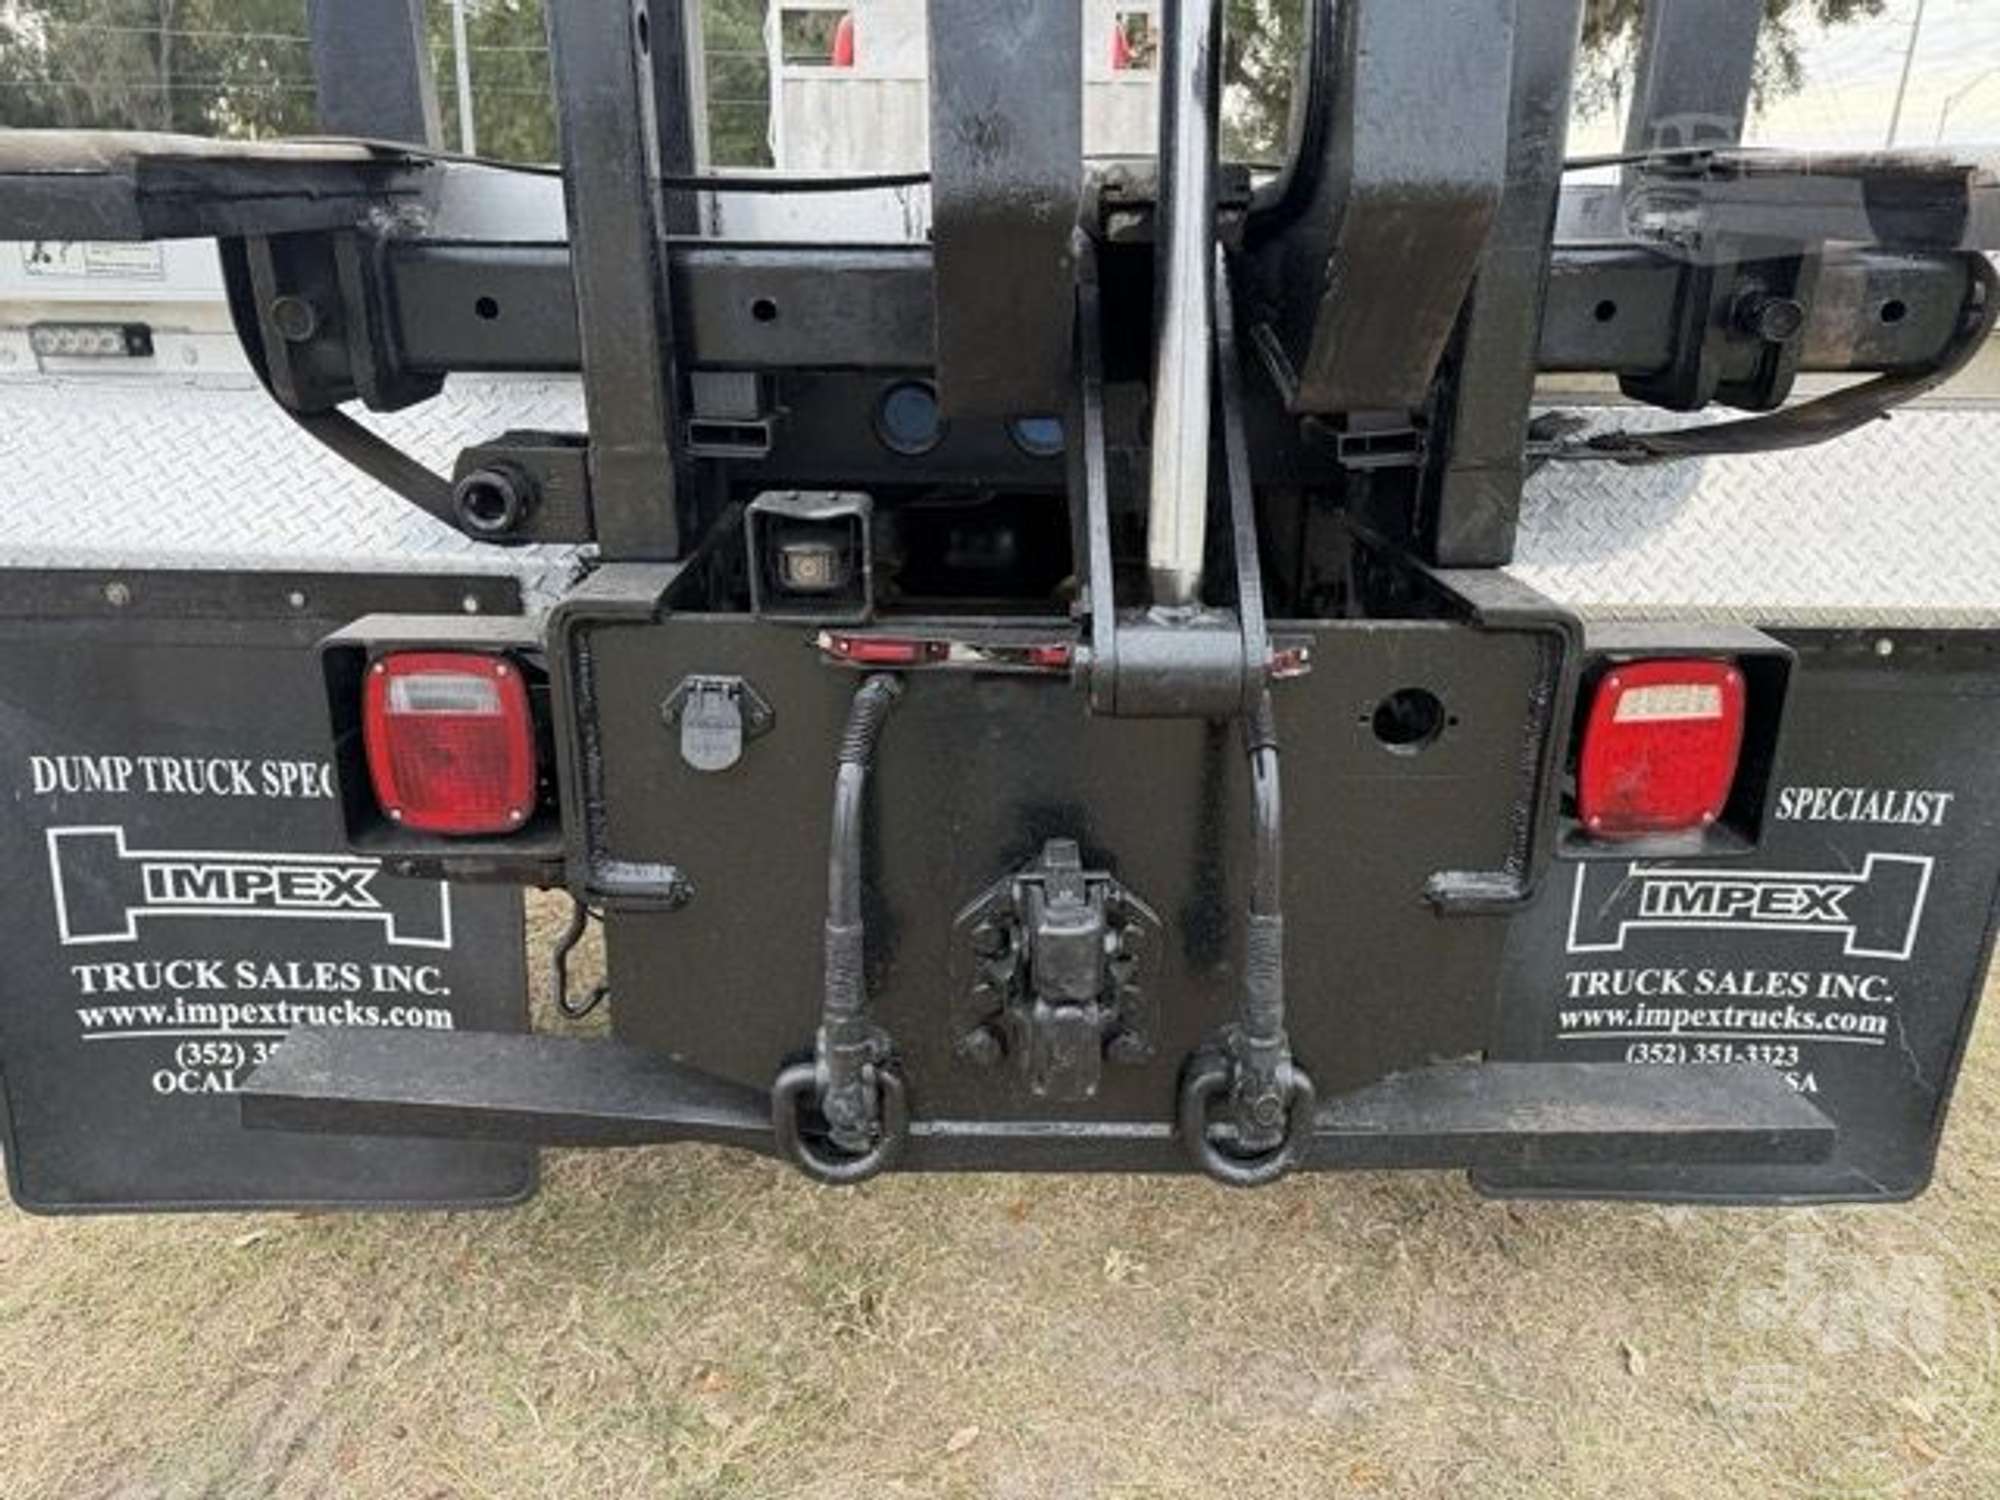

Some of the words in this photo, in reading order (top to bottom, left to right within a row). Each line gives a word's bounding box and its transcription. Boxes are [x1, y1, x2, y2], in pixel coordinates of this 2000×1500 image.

[30, 756, 132, 793] DUMP
[138, 757, 257, 796] TRUCK
[1776, 787, 1953, 826] SPECIALIST
[142, 862, 382, 908] IMPEX
[1640, 881, 1855, 922] IMPEX
[72, 961, 227, 995] TRUCK
[237, 963, 361, 992] SALES
[372, 966, 451, 995] INC.
[1566, 969, 1688, 998] TRUCK
[1694, 970, 1808, 998] SALES
[1818, 973, 1894, 1002] INC.
[77, 998, 453, 1031] www.impextrucks.com
[1559, 1004, 1888, 1034] www.impextrucks.com
[175, 1041, 245, 1070] (352)
[1625, 1043, 1686, 1064] (352)
[1692, 1043, 1799, 1067] 351-3323
